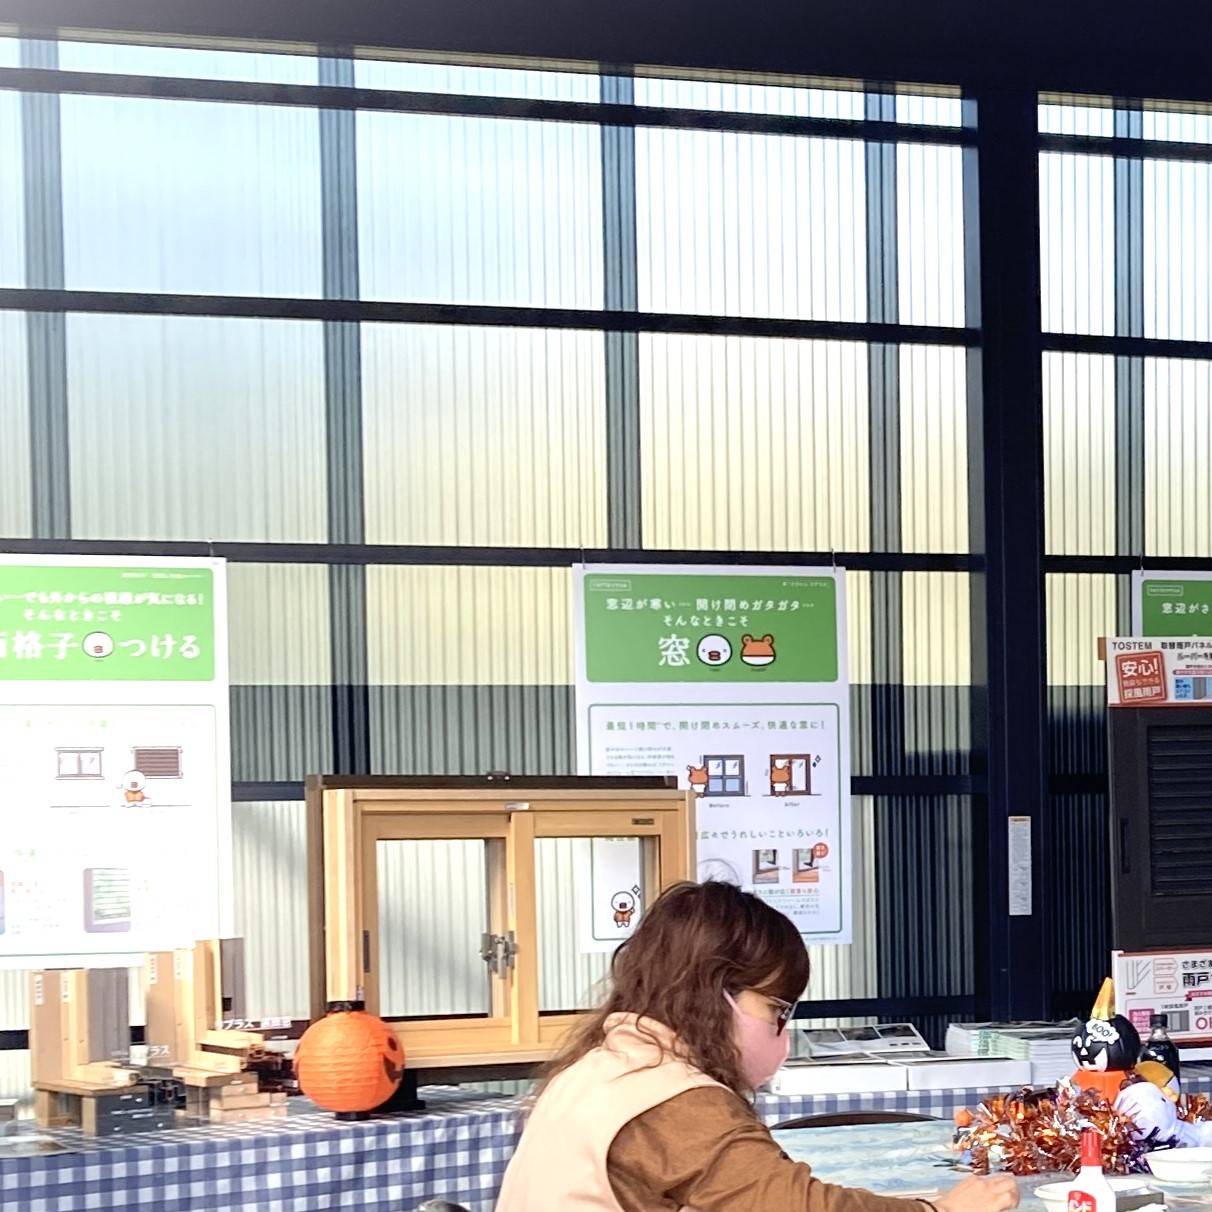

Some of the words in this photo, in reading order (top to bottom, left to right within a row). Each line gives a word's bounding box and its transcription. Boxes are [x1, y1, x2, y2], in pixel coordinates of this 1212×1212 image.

[663, 615, 749, 628] そんなときこそ
[658, 633, 691, 667] 窓
[1112, 641, 1153, 651] TOSTEM
[1121, 658, 1160, 678] 安心!
[1092, 1023, 1114, 1038] BOO!
